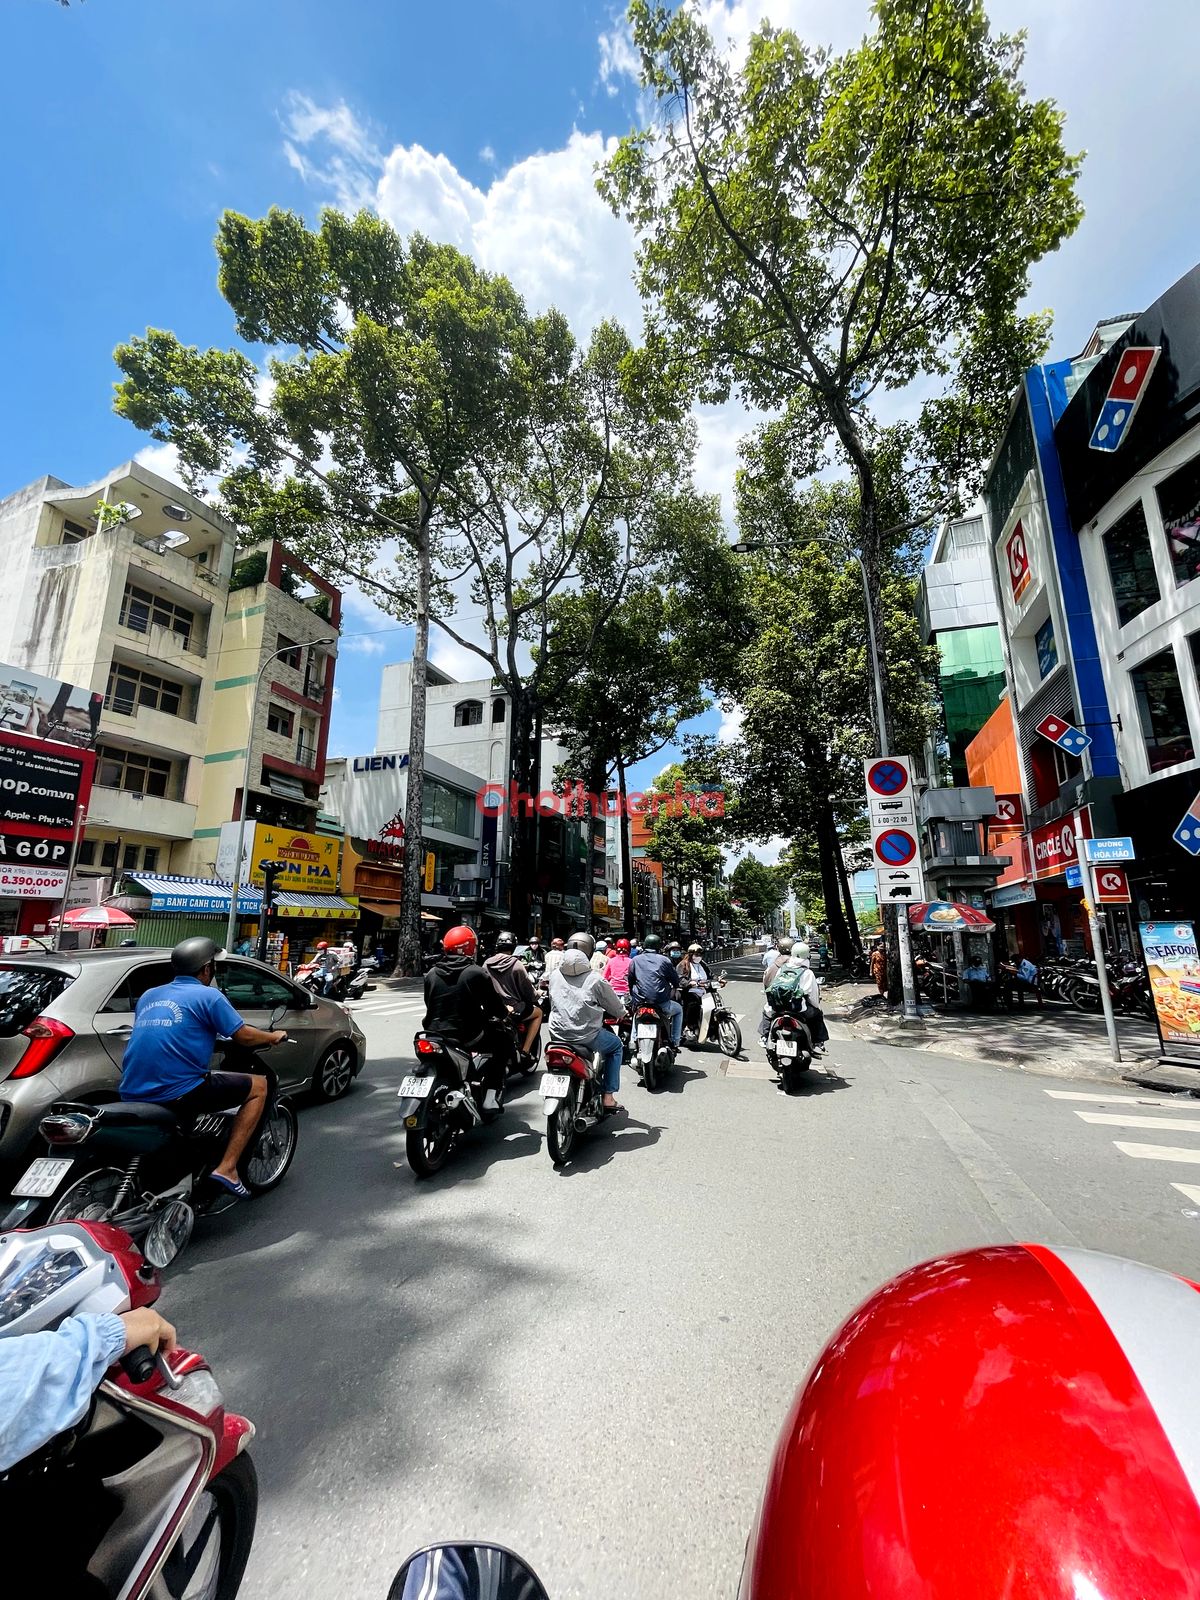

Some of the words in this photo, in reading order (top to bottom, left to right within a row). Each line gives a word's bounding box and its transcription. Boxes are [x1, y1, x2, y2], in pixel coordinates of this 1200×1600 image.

[4, 810, 30, 820] Apple
[16, 839, 66, 860] GÓP
[1036, 834, 1062, 860] CIRCLE
[1145, 945, 1198, 960] SEAFOOD
